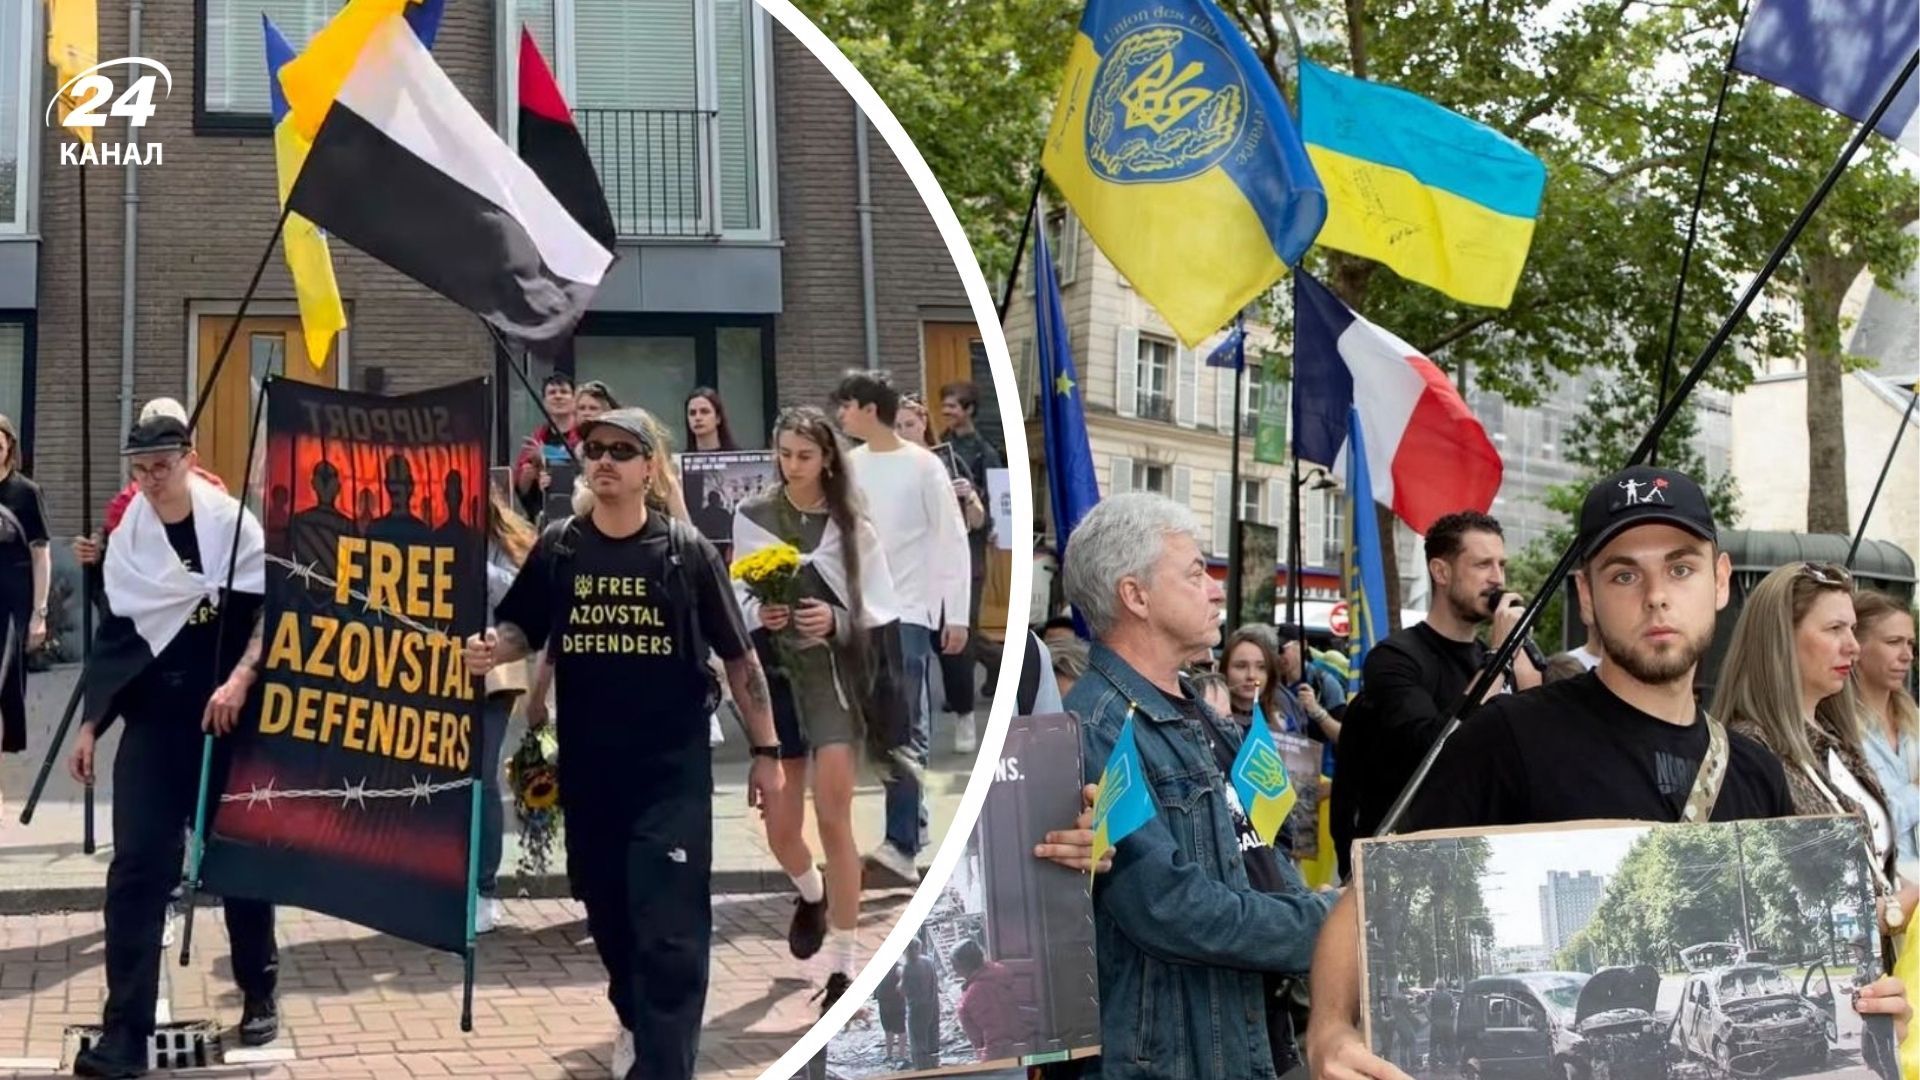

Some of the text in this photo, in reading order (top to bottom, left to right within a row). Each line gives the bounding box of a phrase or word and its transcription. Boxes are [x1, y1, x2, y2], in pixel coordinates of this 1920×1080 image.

[1104, 10, 1150, 44] Union
[1153, 5, 1185, 21] des
[335, 535, 455, 619] FREE
[598, 577, 647, 597] FREE
[569, 605, 665, 627] AZOVSTAL
[266, 611, 475, 700] AZOVSTAL
[562, 634, 673, 656] DEFENDERS
[258, 683, 472, 772] DEFENDERS
[995, 756, 1025, 782] NS.
[1236, 829, 1267, 851] AL
